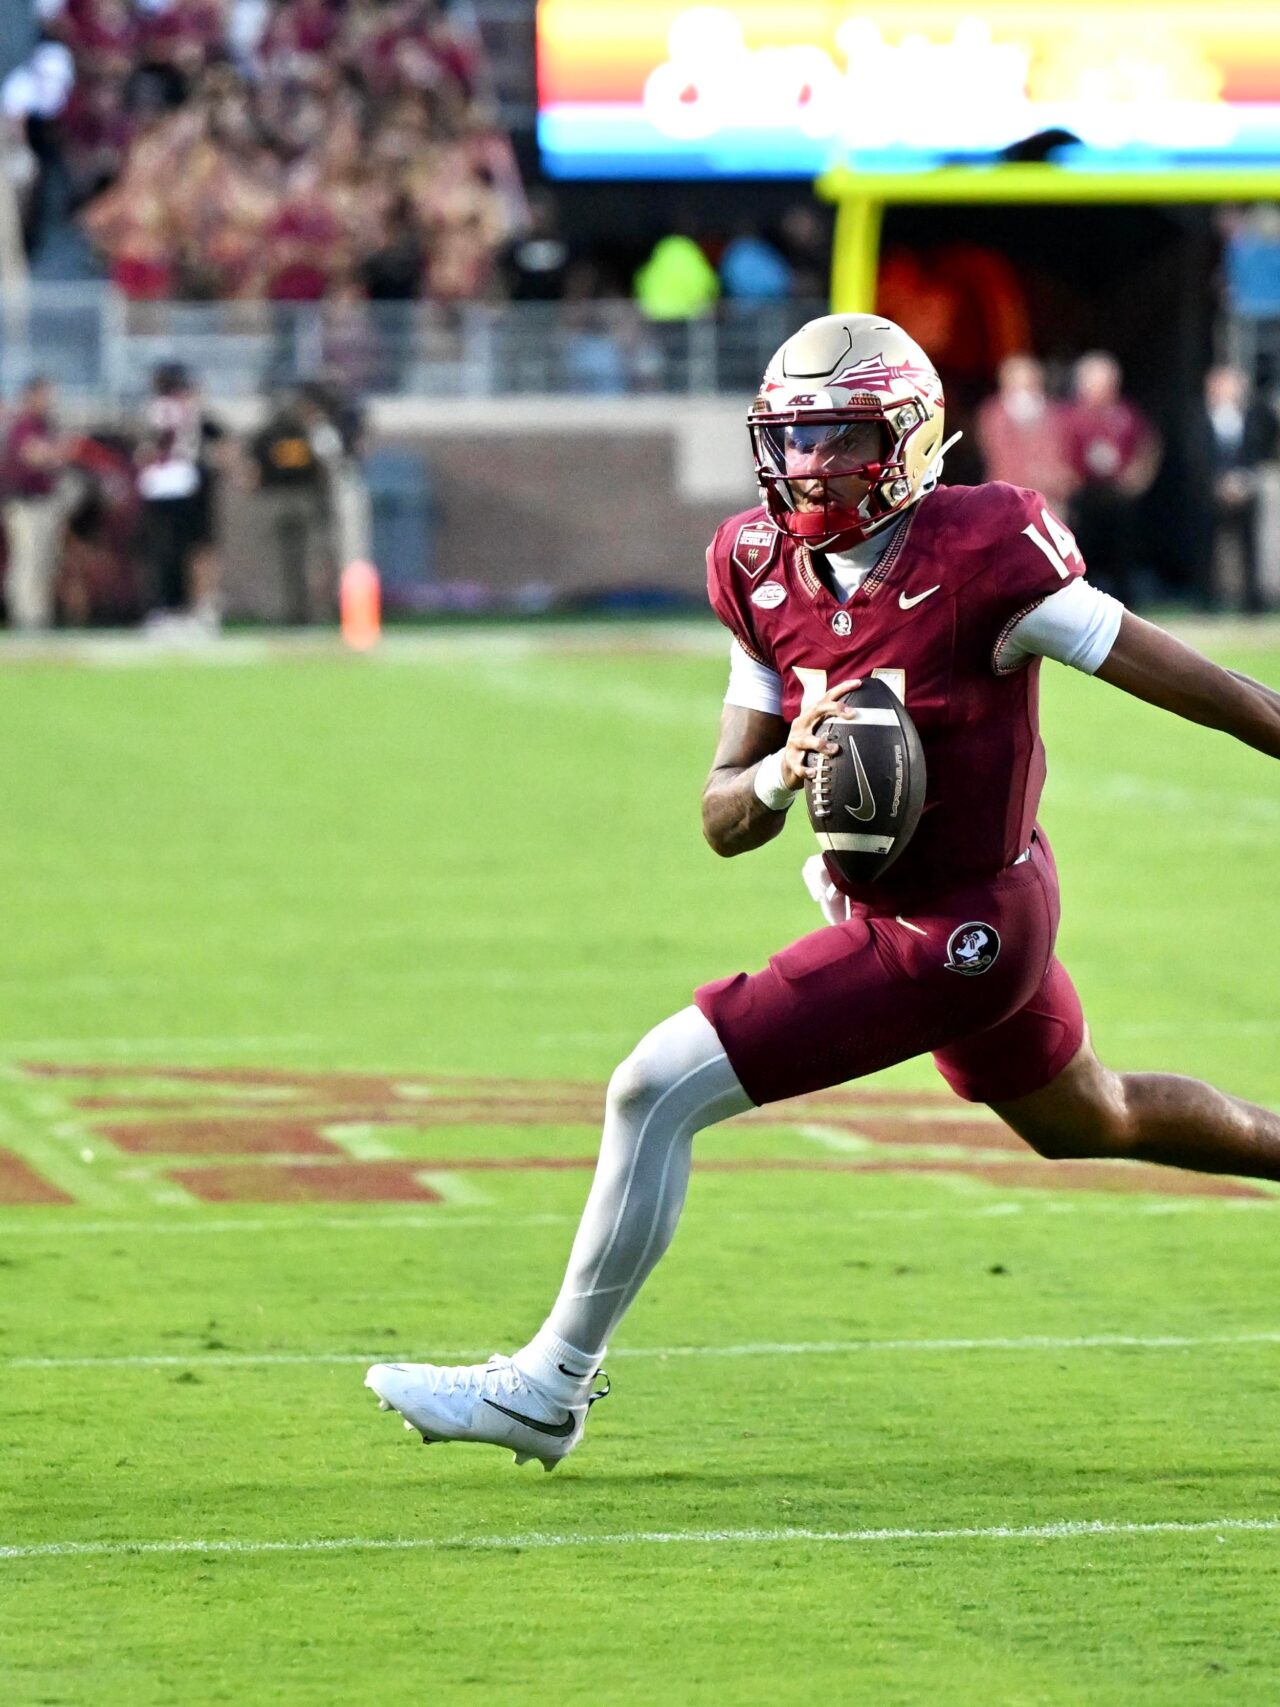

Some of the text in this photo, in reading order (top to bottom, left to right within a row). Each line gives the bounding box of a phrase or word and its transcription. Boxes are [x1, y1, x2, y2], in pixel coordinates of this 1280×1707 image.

[786, 394, 817, 406] ACC
[1020, 508, 1082, 580] 14
[758, 588, 781, 599] ACC
